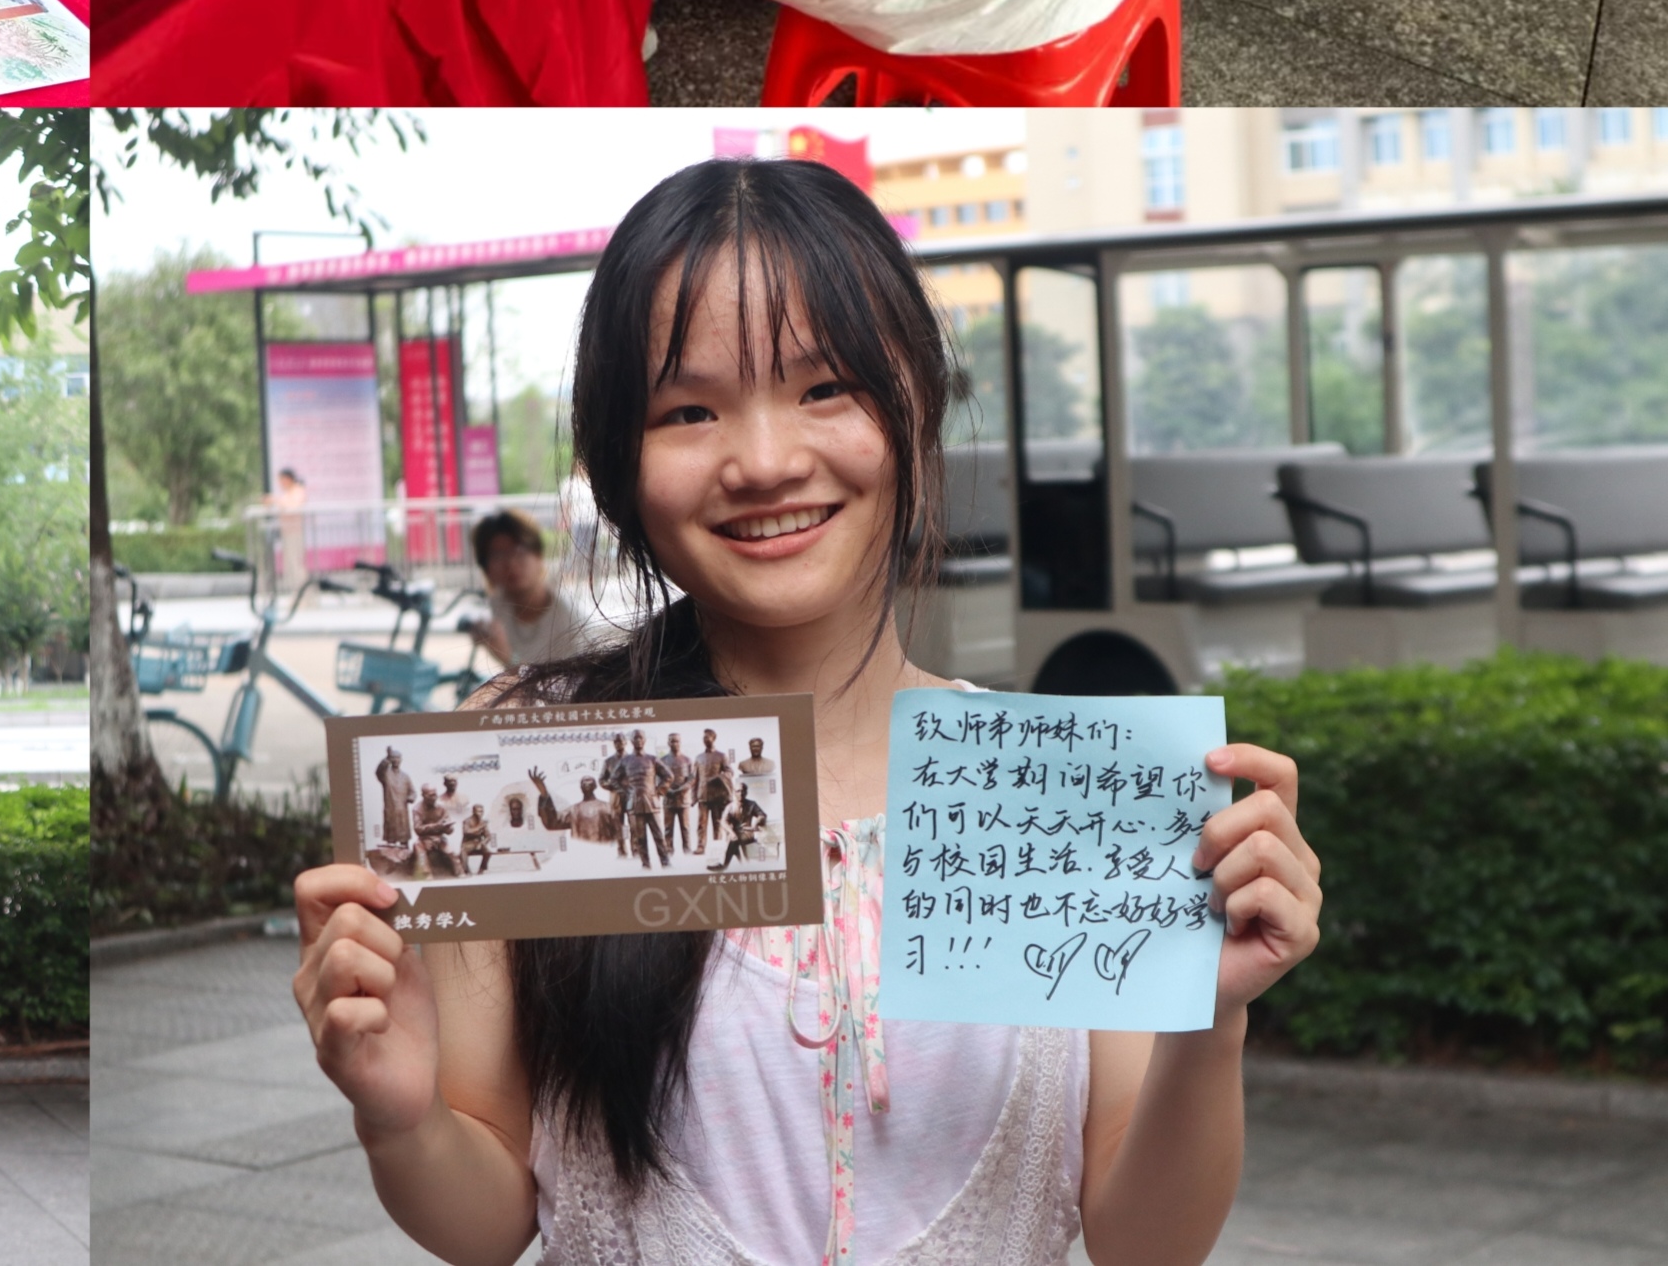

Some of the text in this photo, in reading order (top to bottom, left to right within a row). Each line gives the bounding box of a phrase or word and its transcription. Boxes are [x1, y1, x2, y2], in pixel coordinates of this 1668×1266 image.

[912, 756, 1207, 807] 在大学期间希望你
[394, 911, 477, 930] 独秀学人
[633, 882, 790, 928] GXNU
[902, 886, 1209, 930] 的同时也不忘好好学
